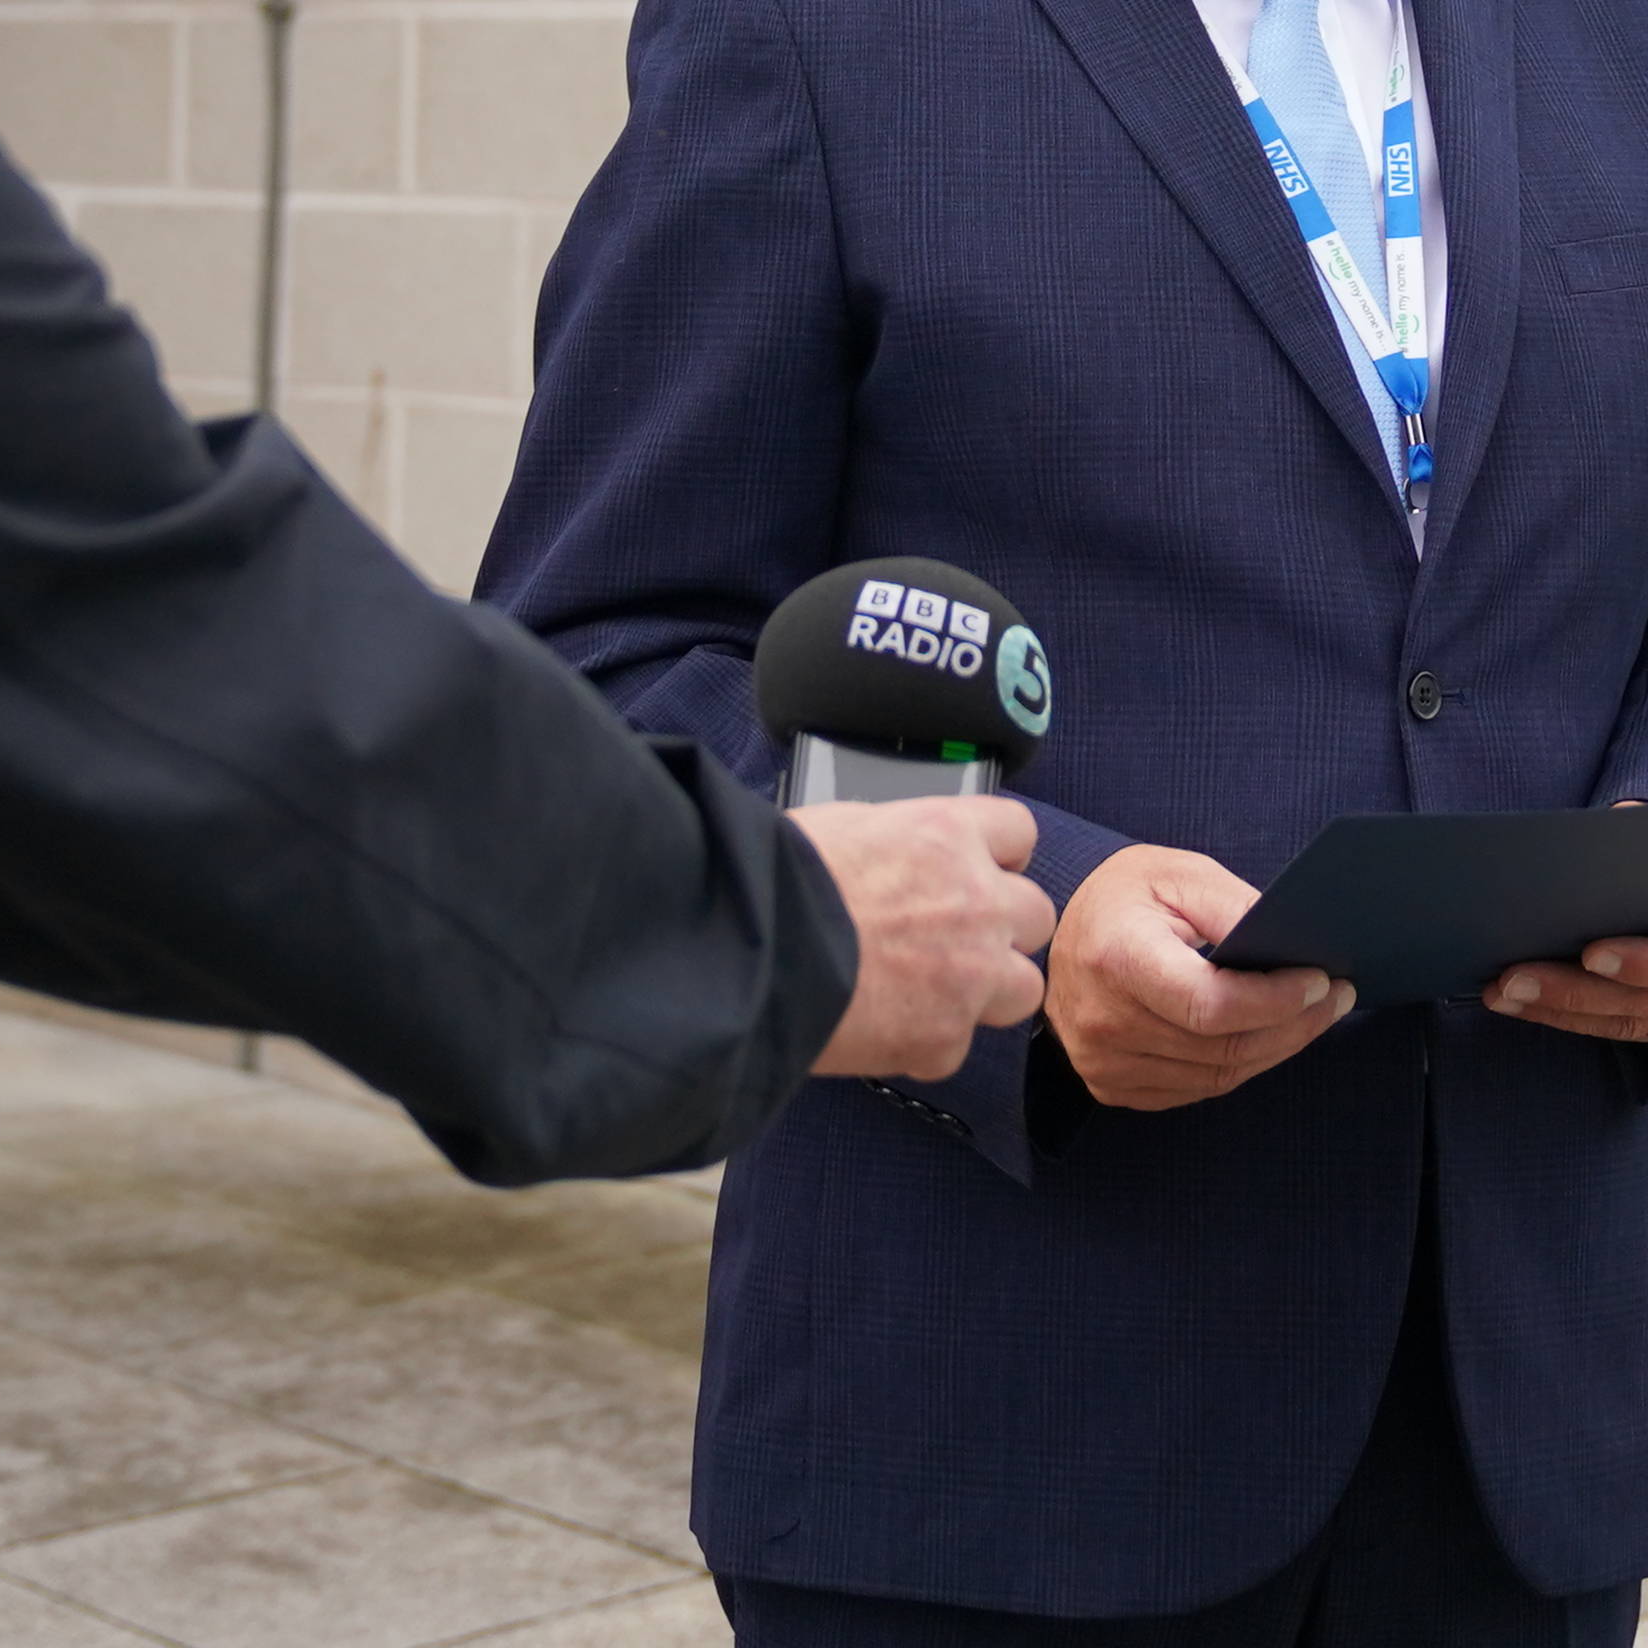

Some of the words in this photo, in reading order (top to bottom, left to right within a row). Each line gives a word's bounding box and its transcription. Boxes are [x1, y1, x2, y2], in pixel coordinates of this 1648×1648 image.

[1264, 143, 1307, 194] NHS
[1389, 145, 1411, 193] NHS
[1397, 263, 1406, 292] name
[1348, 280, 1362, 298] my
[1359, 298, 1379, 329] name
[1398, 294, 1410, 311] my
[861, 583, 986, 641] BBC
[847, 614, 984, 679] RADIO
